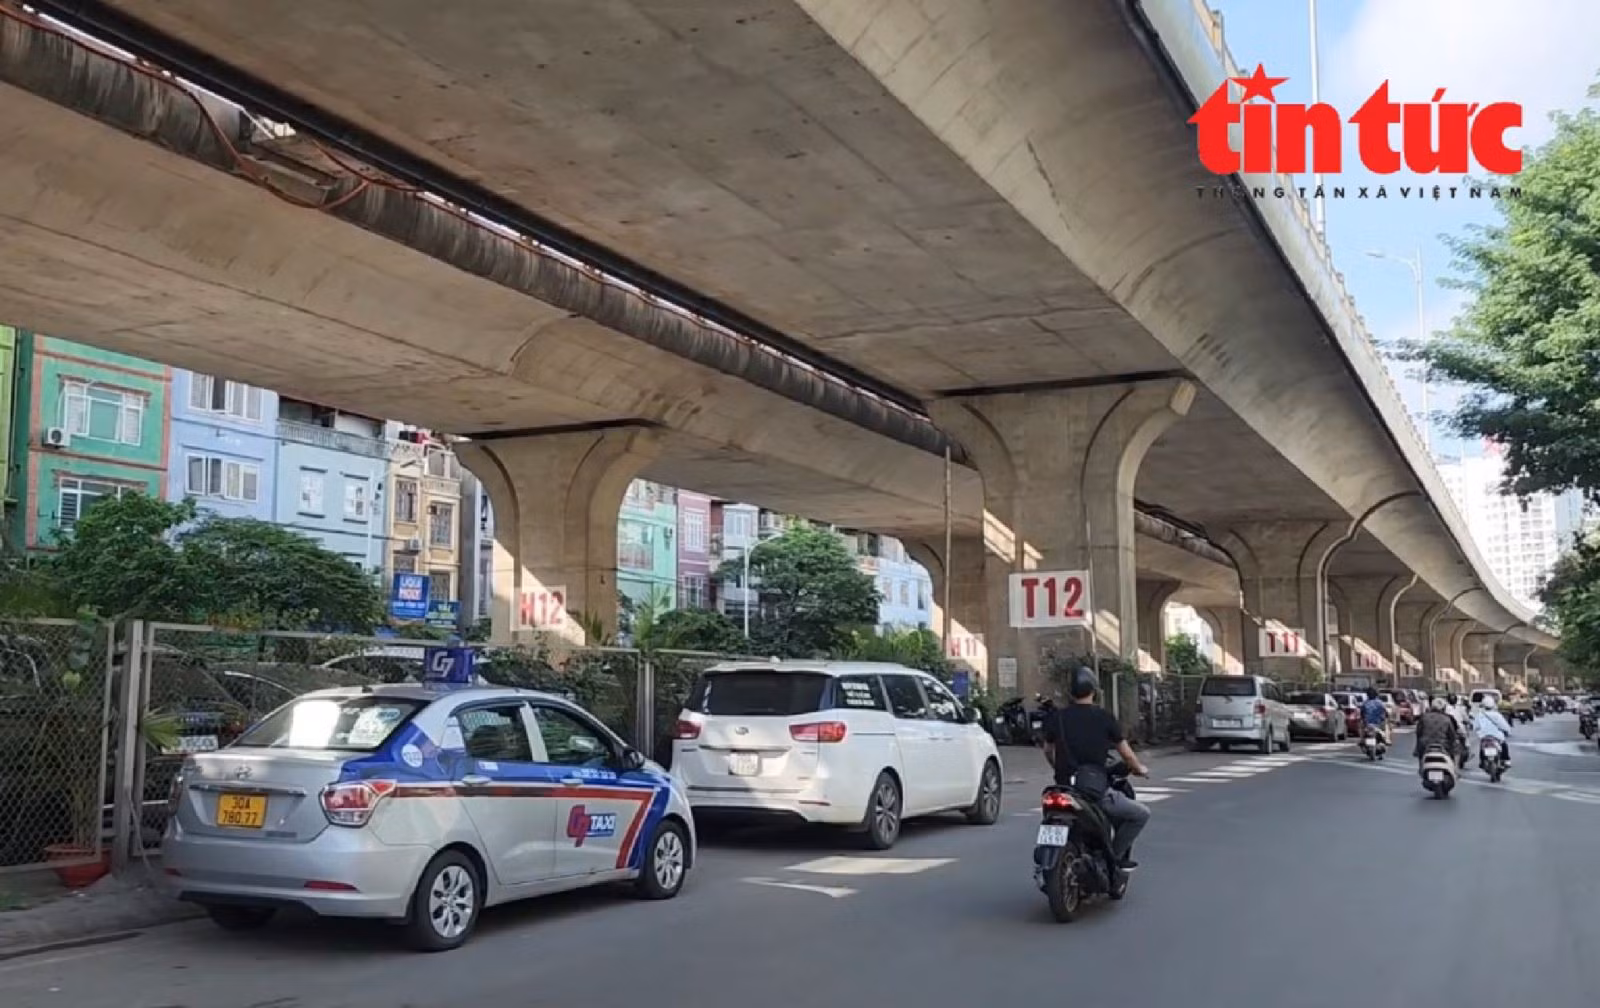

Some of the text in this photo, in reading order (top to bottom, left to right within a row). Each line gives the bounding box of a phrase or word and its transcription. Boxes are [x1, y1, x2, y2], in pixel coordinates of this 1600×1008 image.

[519, 591, 563, 625] H12
[1021, 577, 1085, 618] T12
[432, 651, 456, 677] G7
[590, 814, 616, 830] TAXI
